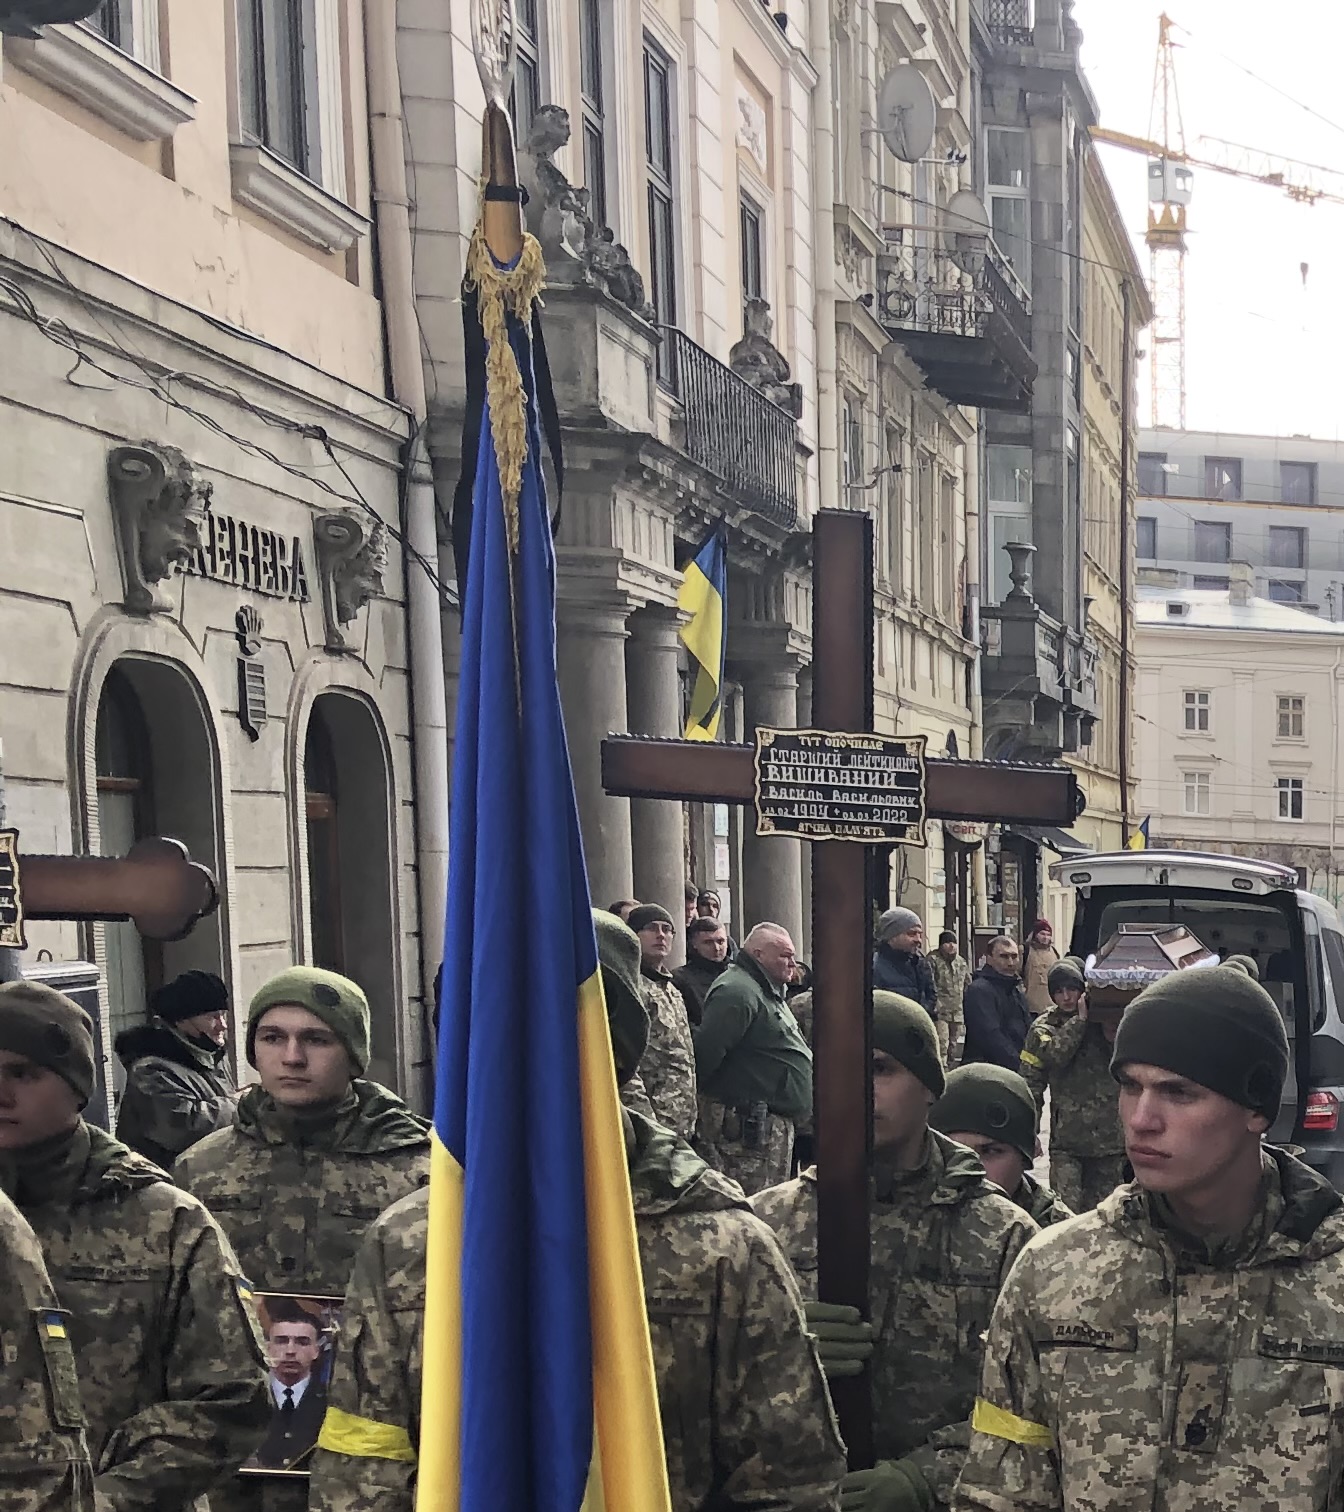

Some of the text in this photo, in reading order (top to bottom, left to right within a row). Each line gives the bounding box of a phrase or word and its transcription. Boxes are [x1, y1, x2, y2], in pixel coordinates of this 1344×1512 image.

[799, 736, 821, 746] ТУТ
[770, 748, 841, 767] СТАРШИЙ
[767, 765, 896, 786] ВИШИВАНИЙ
[798, 822, 832, 833] ВІЧНА
